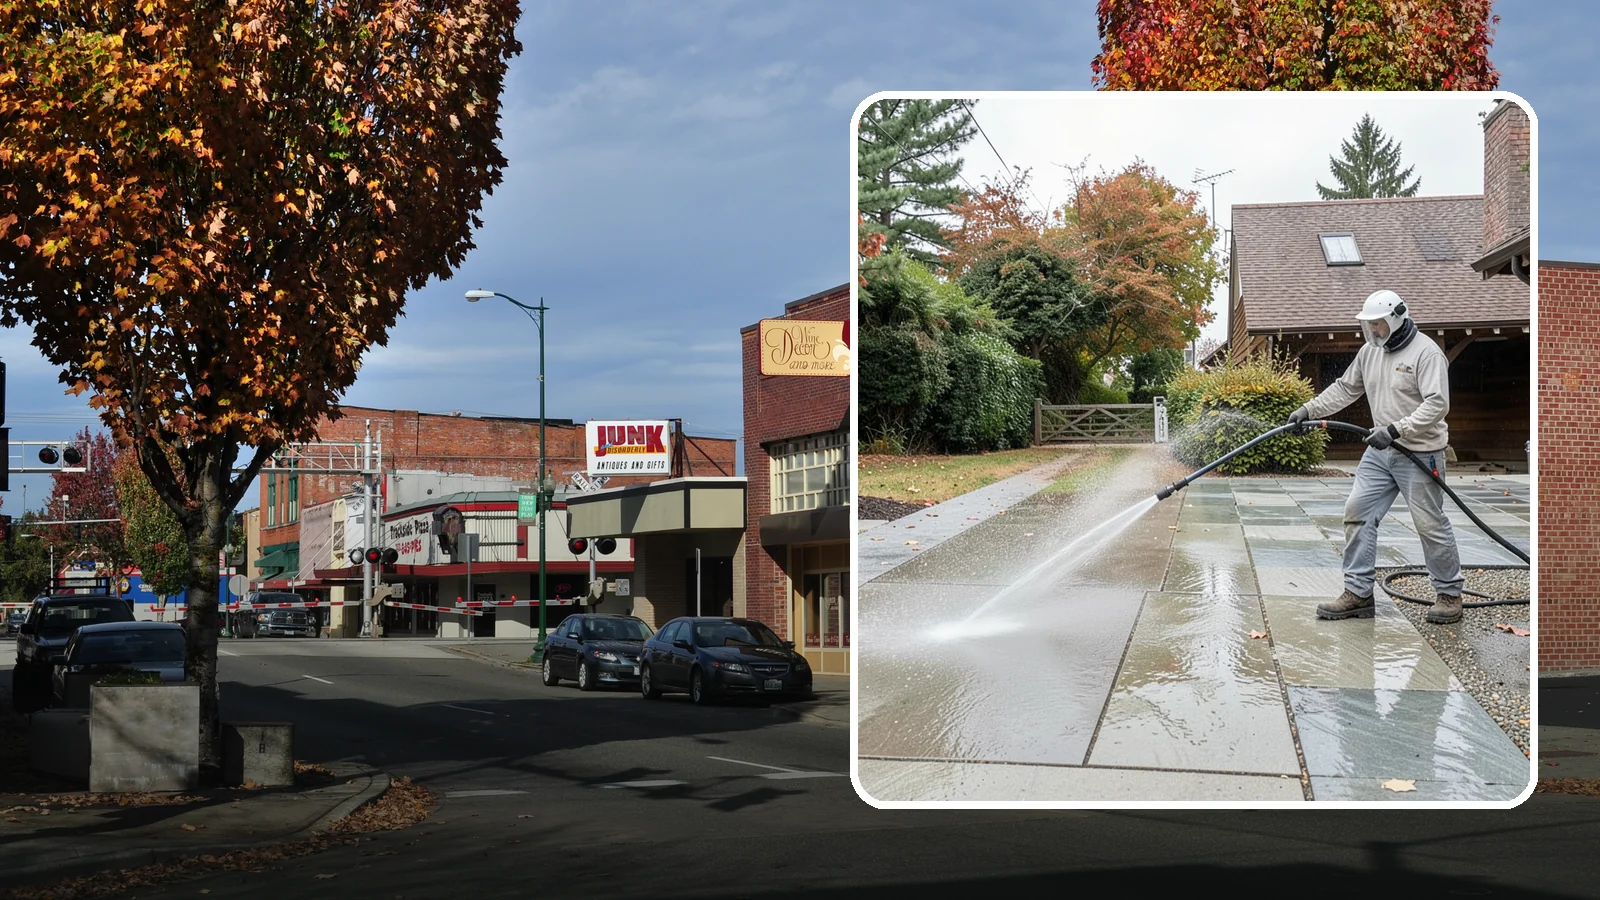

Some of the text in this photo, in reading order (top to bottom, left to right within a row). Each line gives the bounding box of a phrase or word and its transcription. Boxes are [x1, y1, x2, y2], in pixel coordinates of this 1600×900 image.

[595, 425, 664, 457] JUNK
[607, 446, 646, 454] DISORDERLY
[596, 460, 666, 470] ANTIQUES AND GIFTS
[390, 519, 429, 539] Trackside Pizza
